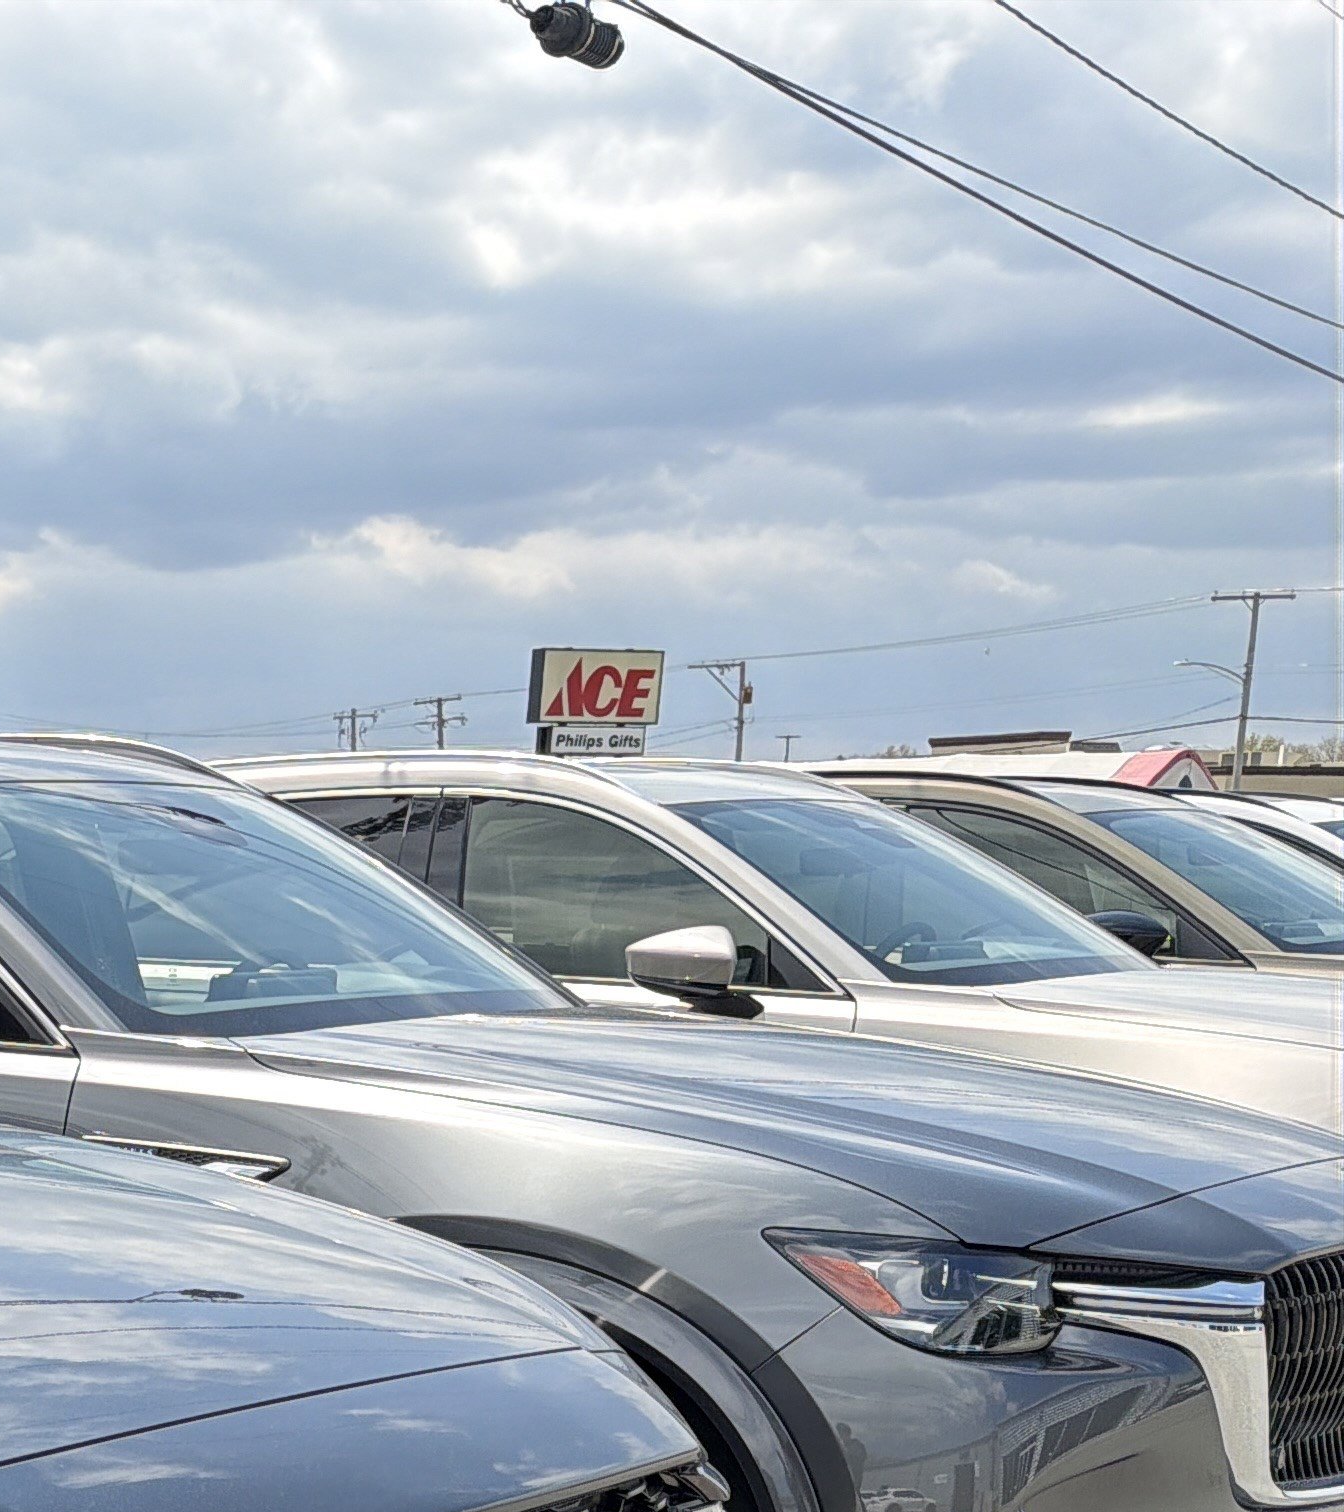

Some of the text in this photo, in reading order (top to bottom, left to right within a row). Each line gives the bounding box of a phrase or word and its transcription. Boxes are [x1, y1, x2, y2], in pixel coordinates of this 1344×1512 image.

[545, 657, 656, 717] ACE
[555, 734, 641, 750] Philips Gifts
